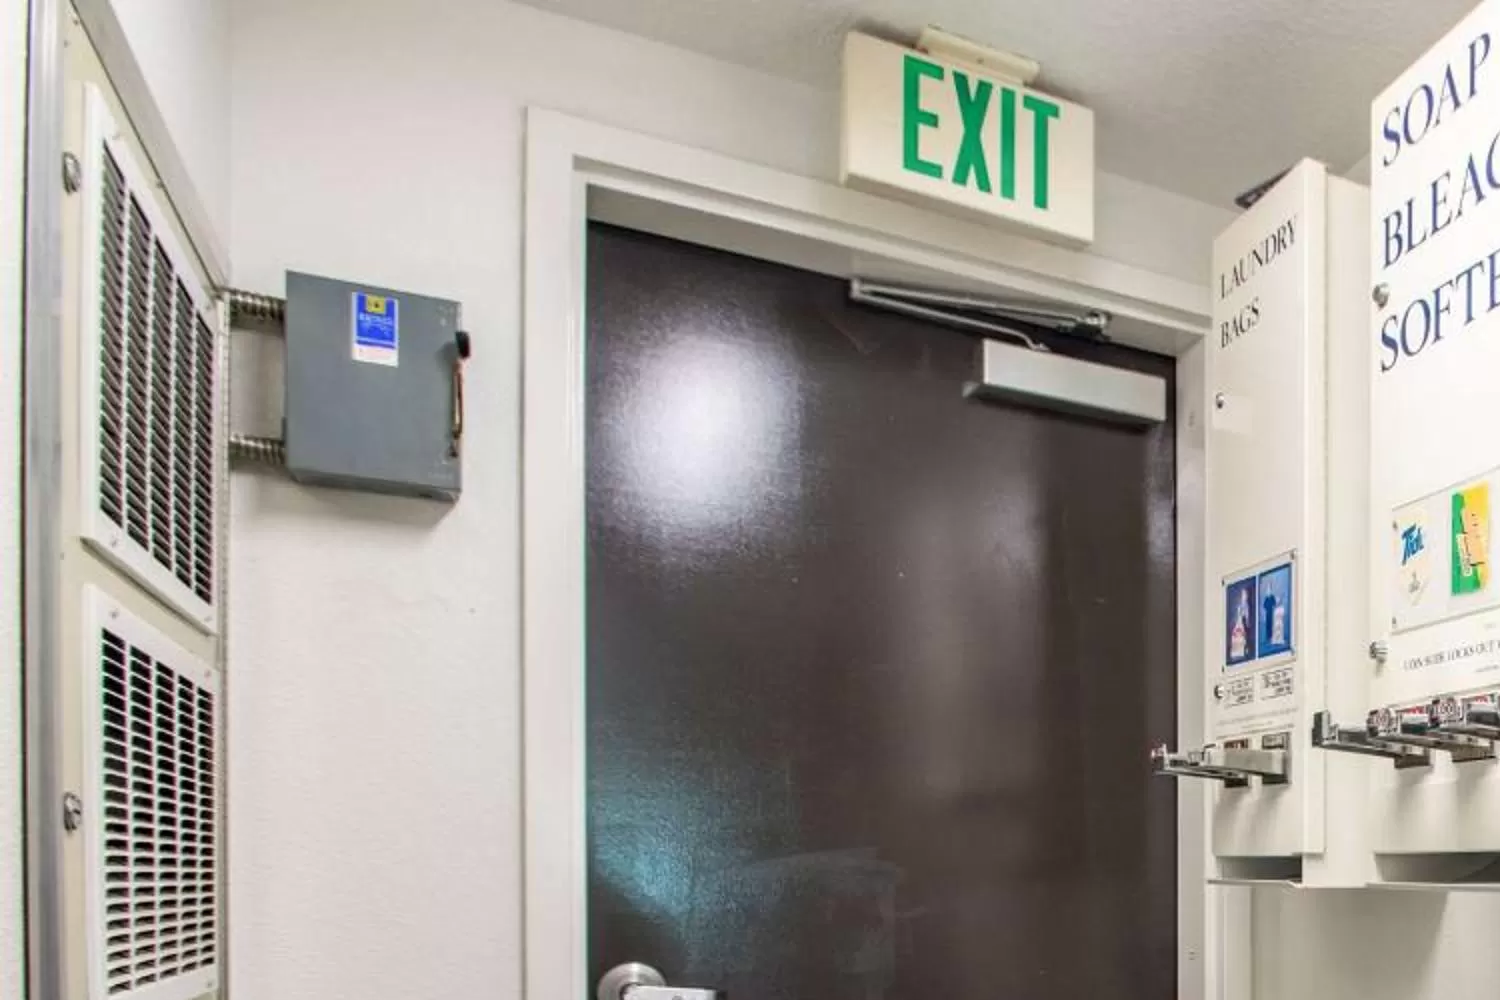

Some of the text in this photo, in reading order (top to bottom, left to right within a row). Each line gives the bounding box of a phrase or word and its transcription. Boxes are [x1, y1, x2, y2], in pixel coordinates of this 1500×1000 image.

[902, 53, 1060, 211] EXIT
[1383, 32, 1491, 168] SOAP
[1219, 213, 1298, 301] LAUNDRY
[1220, 297, 1260, 349] BAGS
